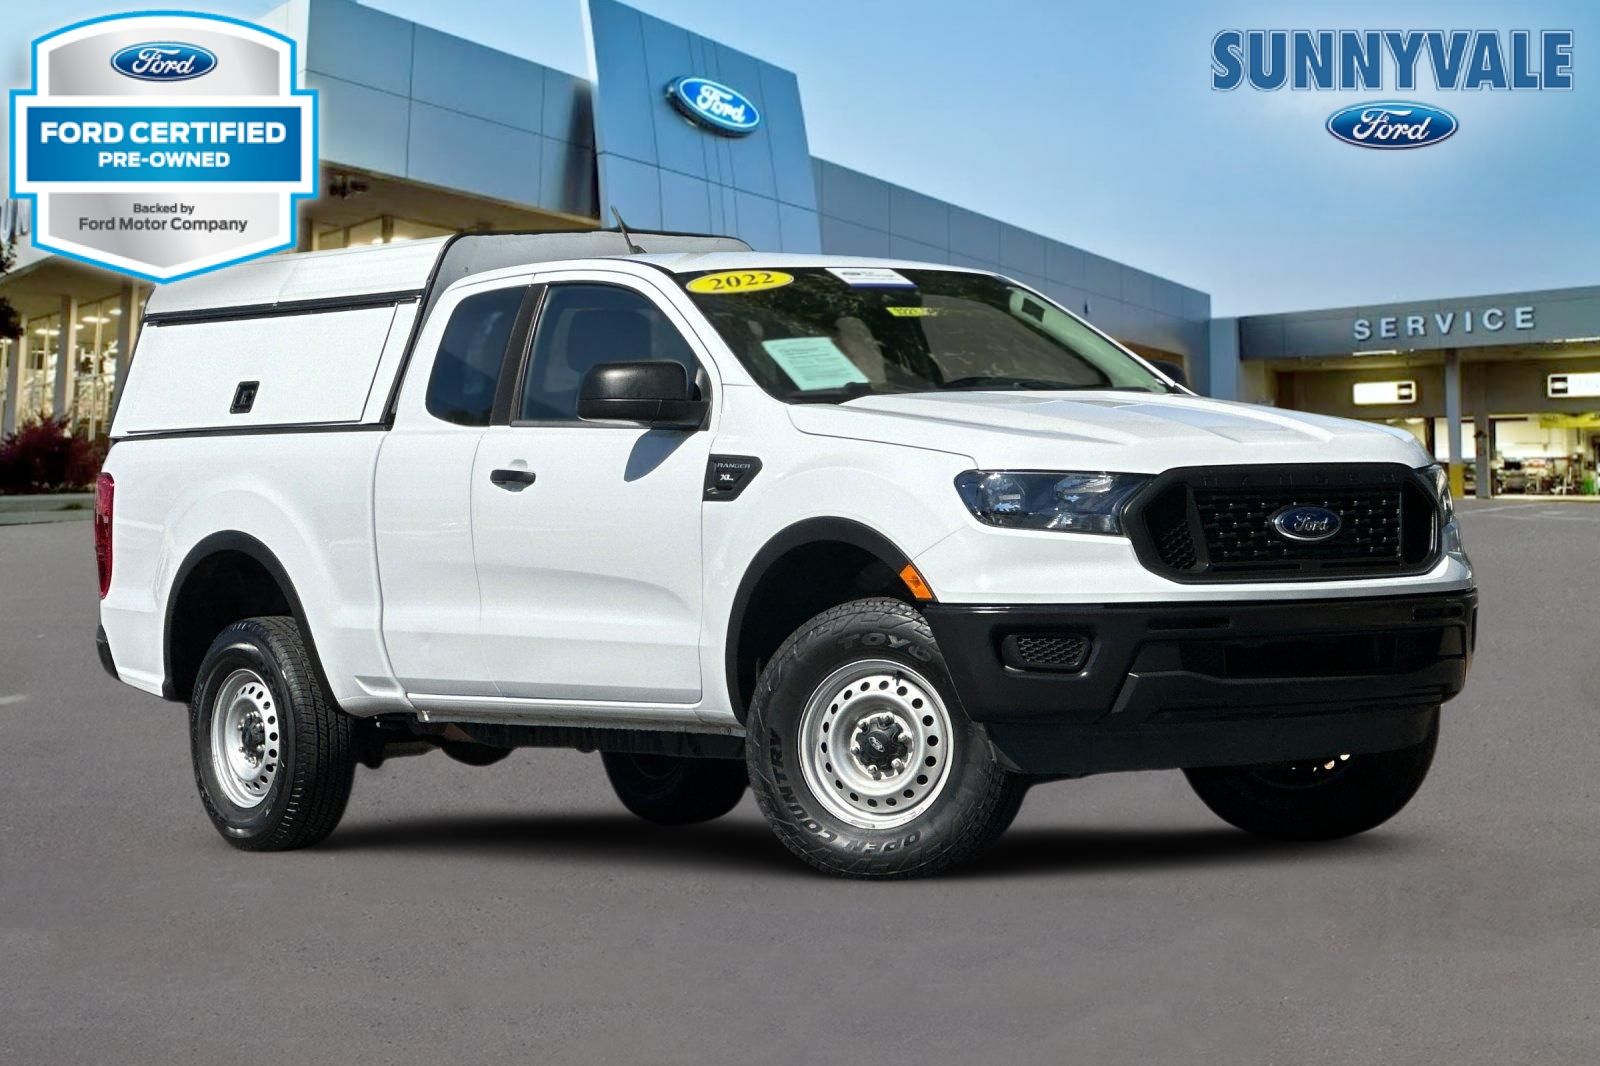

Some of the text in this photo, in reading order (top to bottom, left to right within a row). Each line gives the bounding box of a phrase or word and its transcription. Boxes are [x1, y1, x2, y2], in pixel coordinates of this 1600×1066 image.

[696, 85, 746, 122] Ford
[710, 272, 775, 291] 2022
[1353, 306, 1536, 341] SERVICE
[1294, 513, 1330, 532] Ford
[839, 631, 934, 663] TOYO
